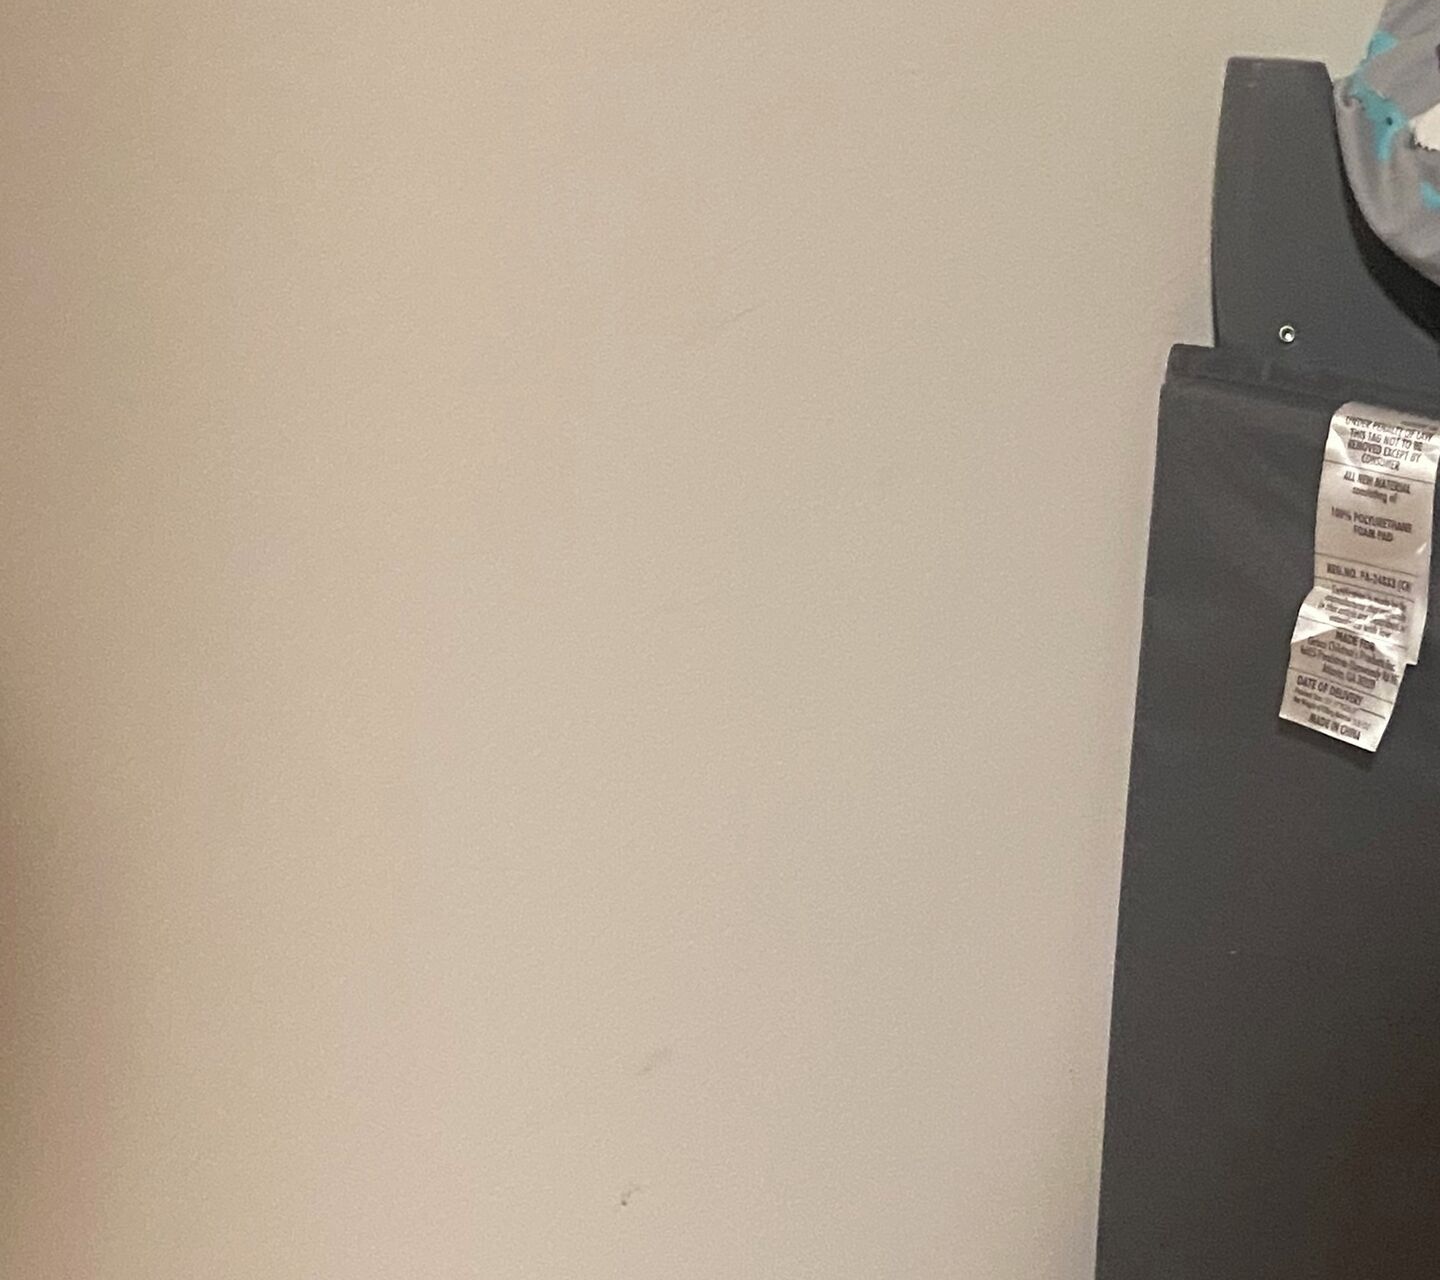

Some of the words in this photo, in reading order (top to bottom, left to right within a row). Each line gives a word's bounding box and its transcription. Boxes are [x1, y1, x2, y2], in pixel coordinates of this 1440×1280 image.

[1350, 428, 1366, 440] THIS
[1367, 431, 1382, 444] TAG
[1383, 435, 1400, 447] NOT
[1402, 439, 1412, 450] TO
[1383, 446, 1408, 461] EXCEPT
[1409, 452, 1421, 463] BY
[1296, 673, 1317, 690] DATE
[1318, 681, 1328, 693] OF
[1329, 685, 1363, 706] DELIVERY
[1340, 725, 1361, 741] CHINA
